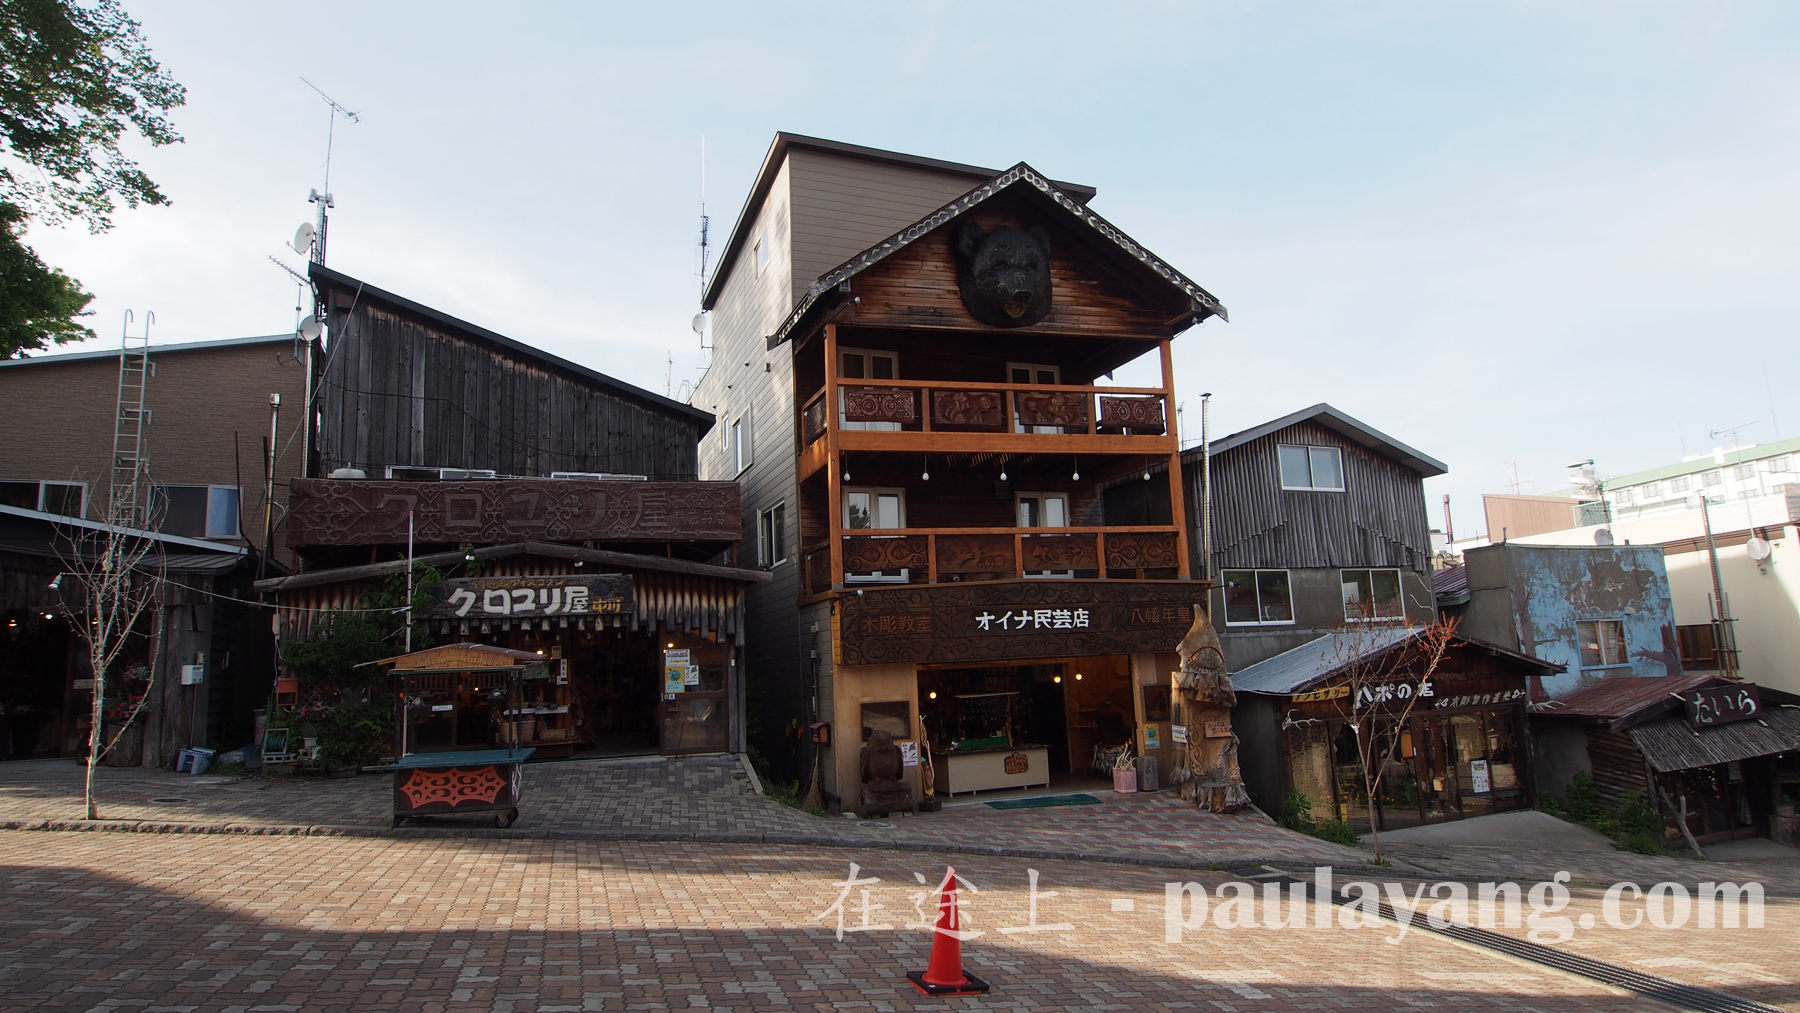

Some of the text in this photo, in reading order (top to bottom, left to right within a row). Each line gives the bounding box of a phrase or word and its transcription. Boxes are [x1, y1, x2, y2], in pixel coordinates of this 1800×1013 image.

[447, 585, 589, 618] クロユリ屋
[861, 614, 933, 633] 木彫教室
[975, 608, 1090, 631] オイナ民芸店
[1130, 606, 1192, 624] 八幡年皇
[1691, 689, 1757, 723] たいら
